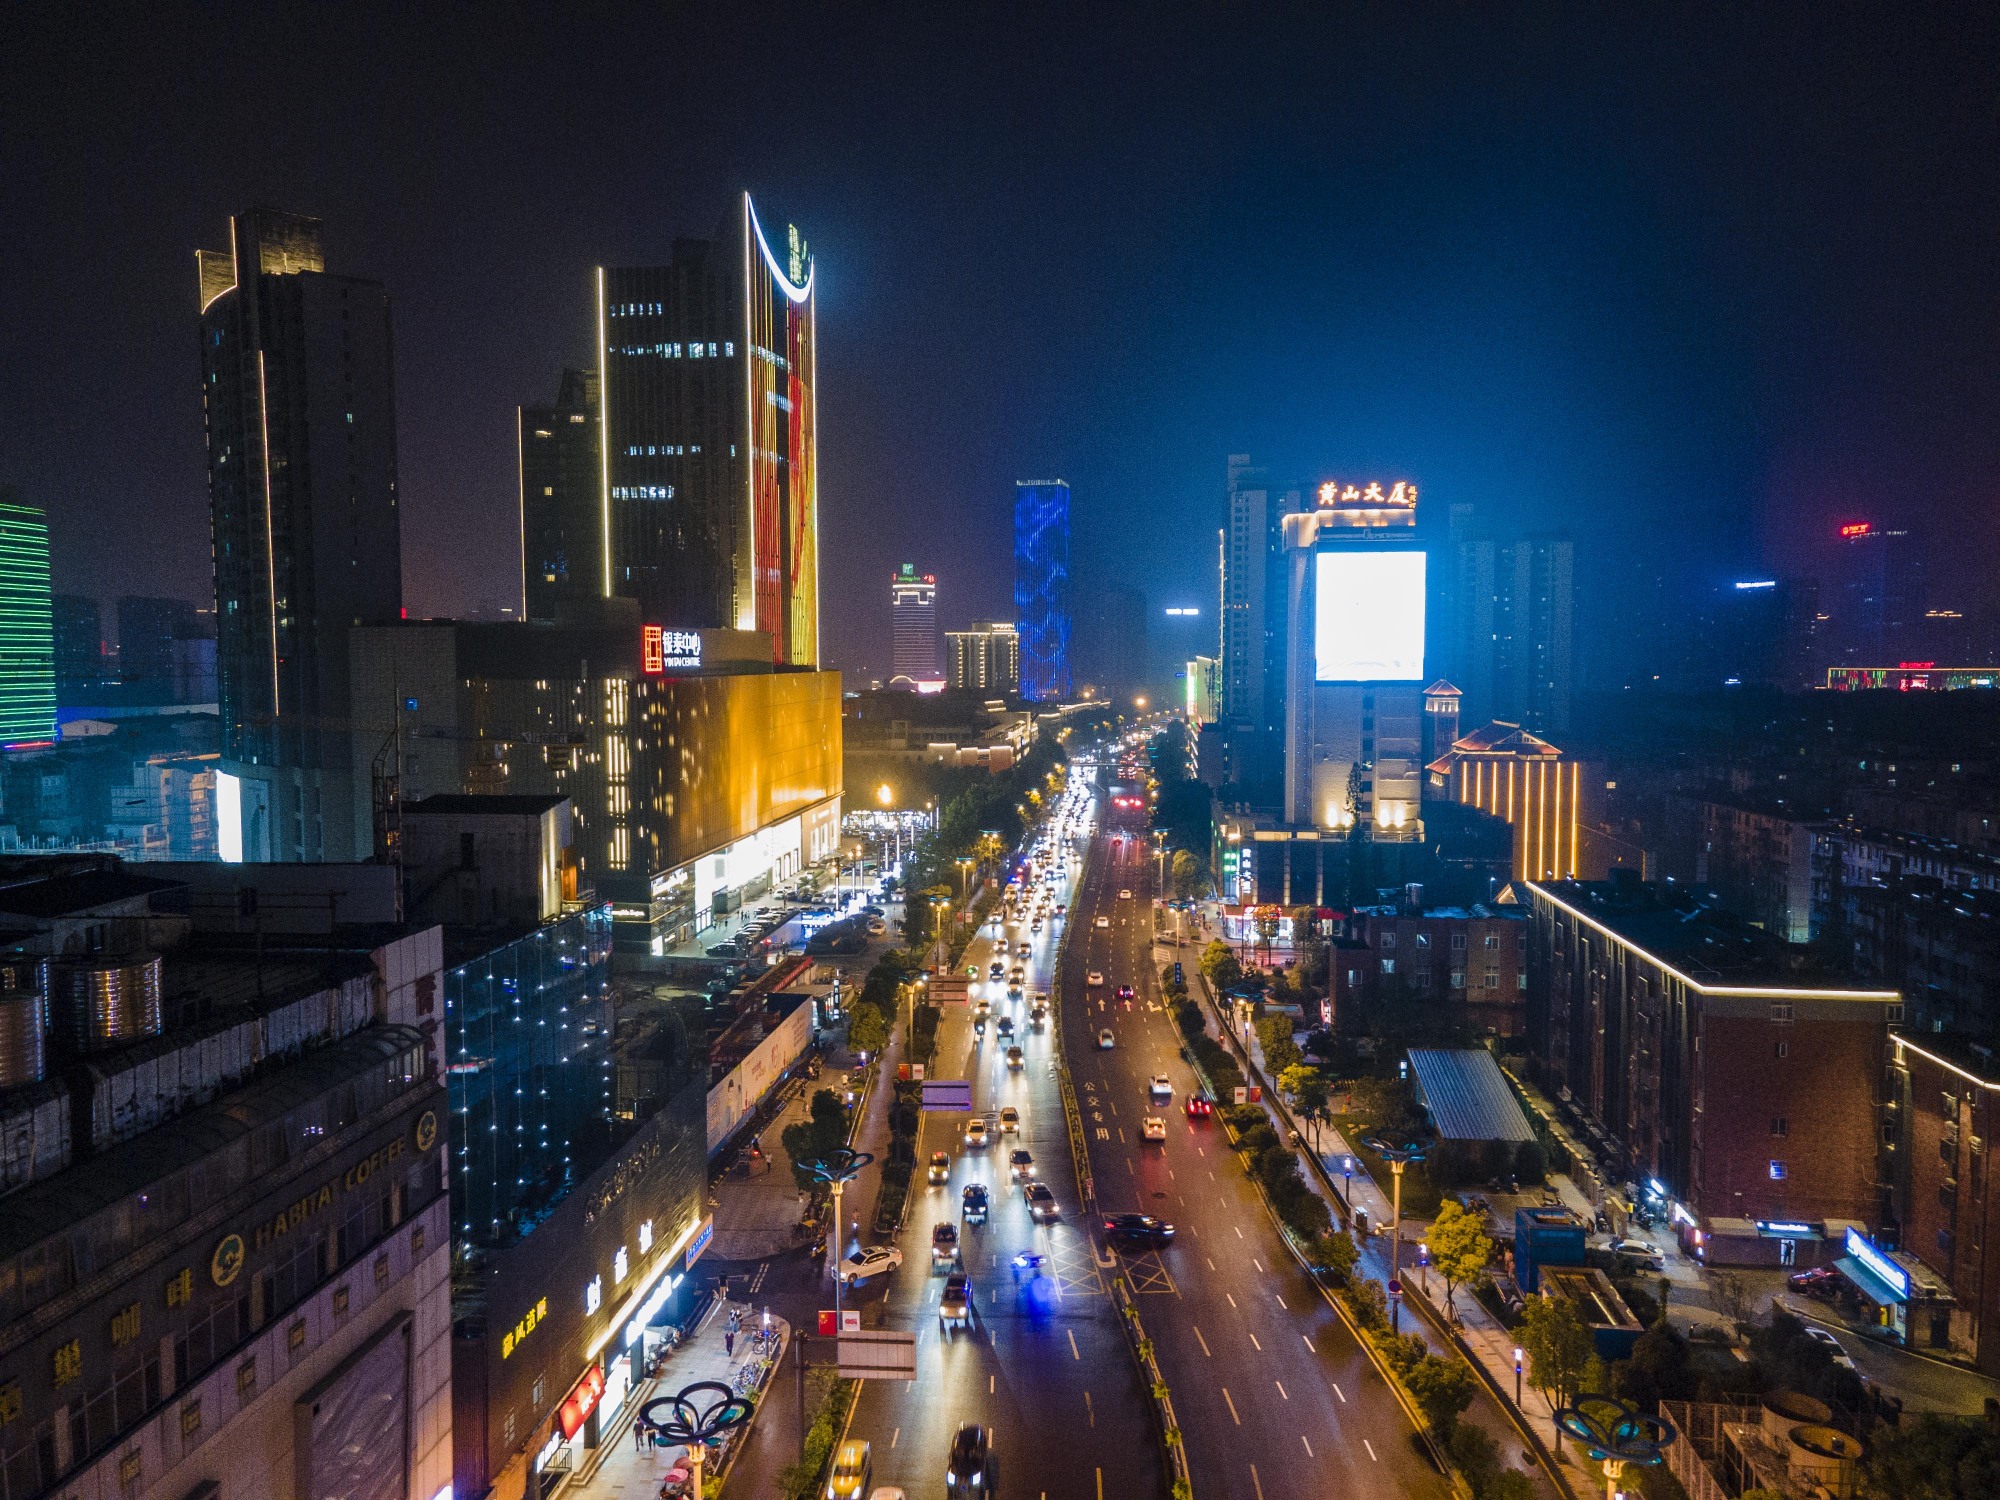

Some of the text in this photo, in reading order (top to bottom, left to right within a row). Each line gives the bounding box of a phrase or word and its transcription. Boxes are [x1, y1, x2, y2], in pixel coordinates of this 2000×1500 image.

[1319, 481, 1409, 505] 黄山大厦
[662, 630, 701, 656] 银泰中心
[1084, 1081, 1110, 1140] 公交专用
[256, 1135, 405, 1249] HABITAT COFFEE
